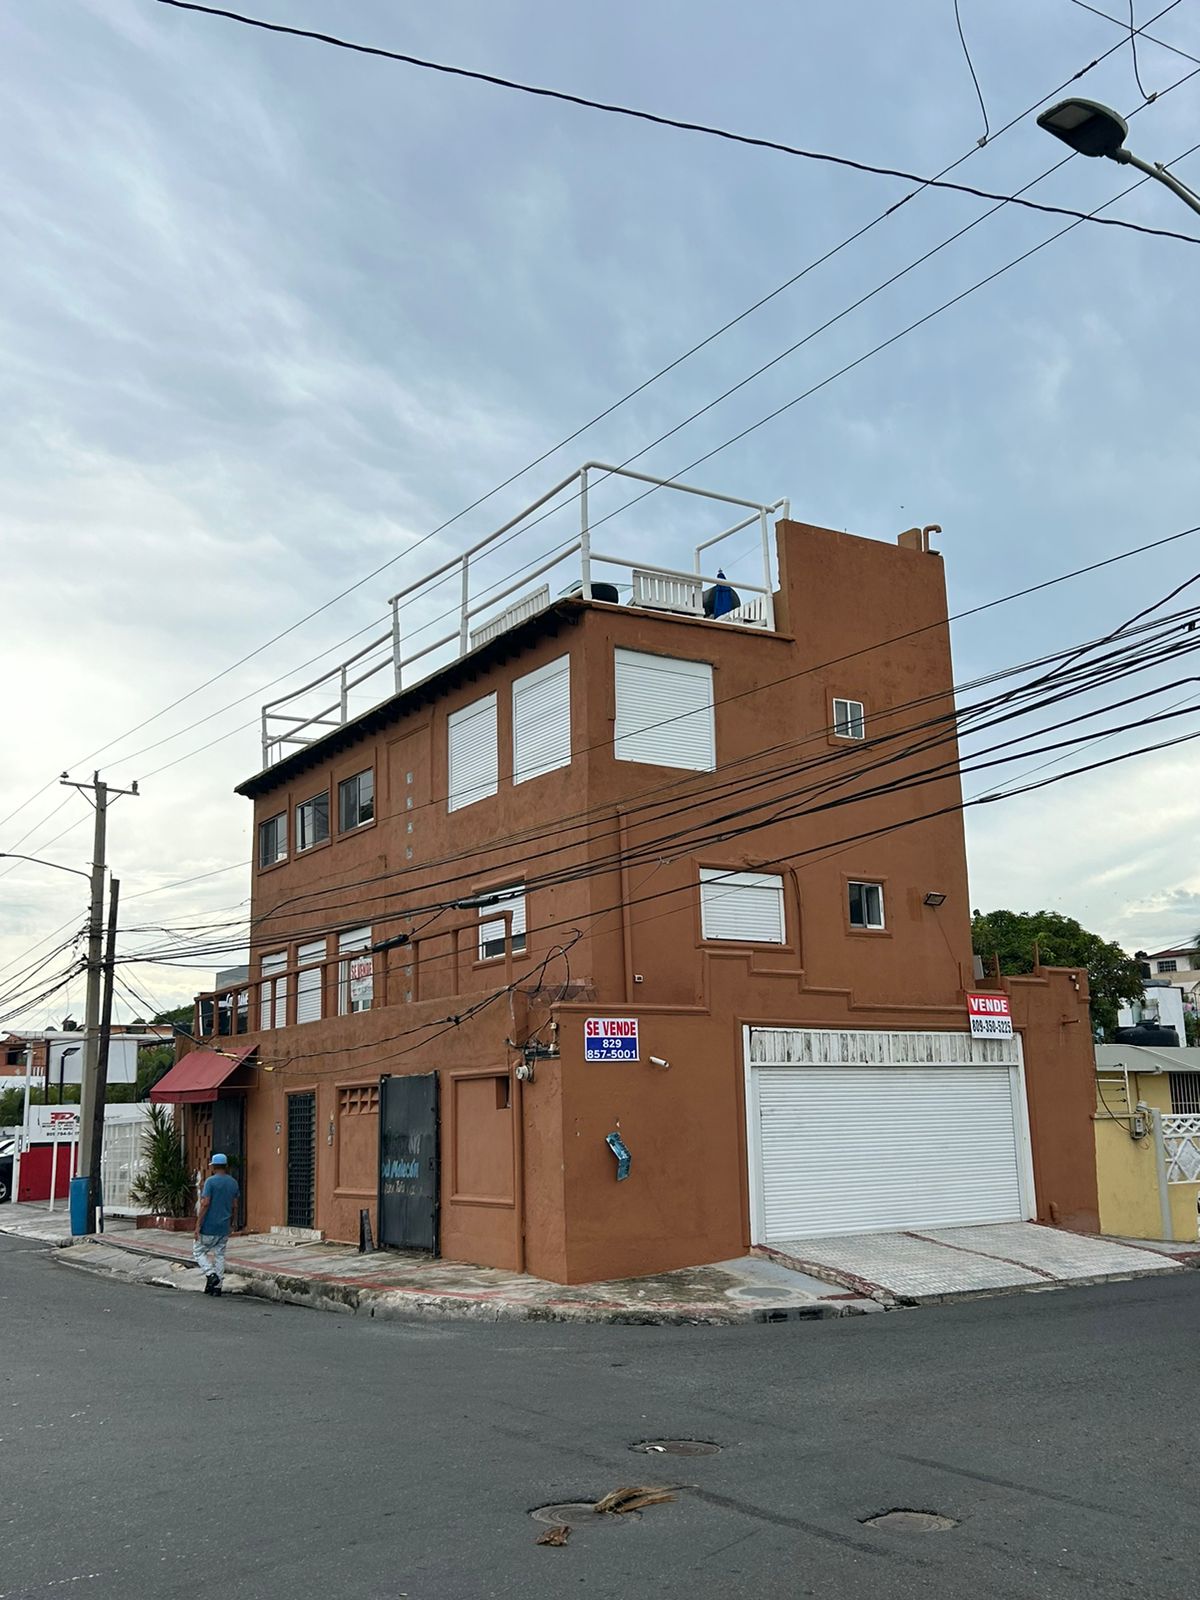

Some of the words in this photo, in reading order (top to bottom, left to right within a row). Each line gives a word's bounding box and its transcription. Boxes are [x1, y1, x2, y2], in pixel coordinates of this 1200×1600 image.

[970, 998, 1008, 1013] VENDE
[586, 1021, 599, 1036] SE
[602, 1021, 636, 1036] VENDE
[972, 1019, 1011, 1033] 809-350-5225
[602, 1039, 622, 1048] 829
[587, 1049, 636, 1058] 857-5001
